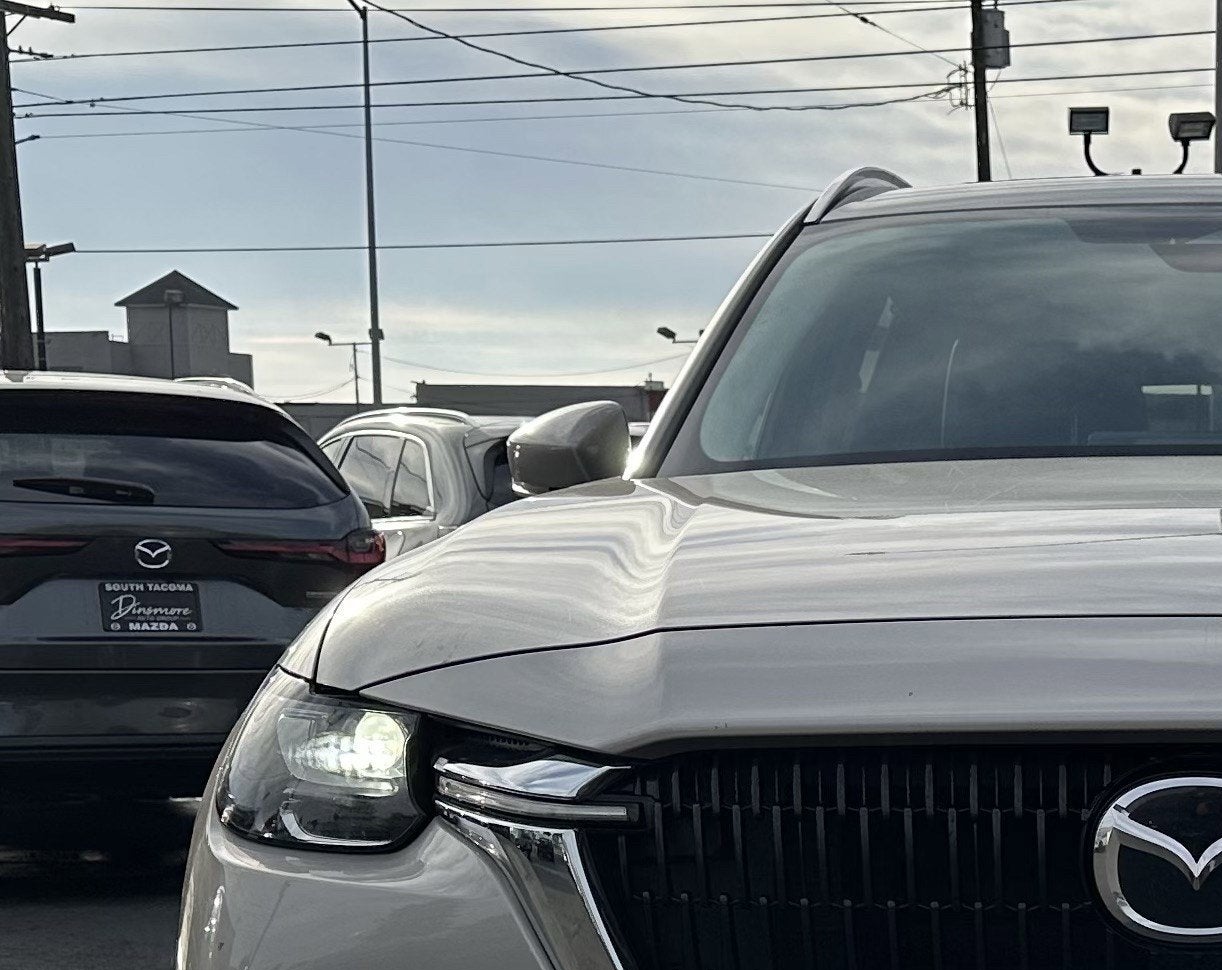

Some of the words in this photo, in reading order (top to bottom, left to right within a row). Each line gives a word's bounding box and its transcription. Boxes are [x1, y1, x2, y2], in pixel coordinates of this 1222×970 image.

[105, 583, 144, 592] SOUTH
[147, 583, 193, 592] TACOMA
[110, 594, 192, 620] Dinsmore
[128, 622, 179, 631] MAZDA
